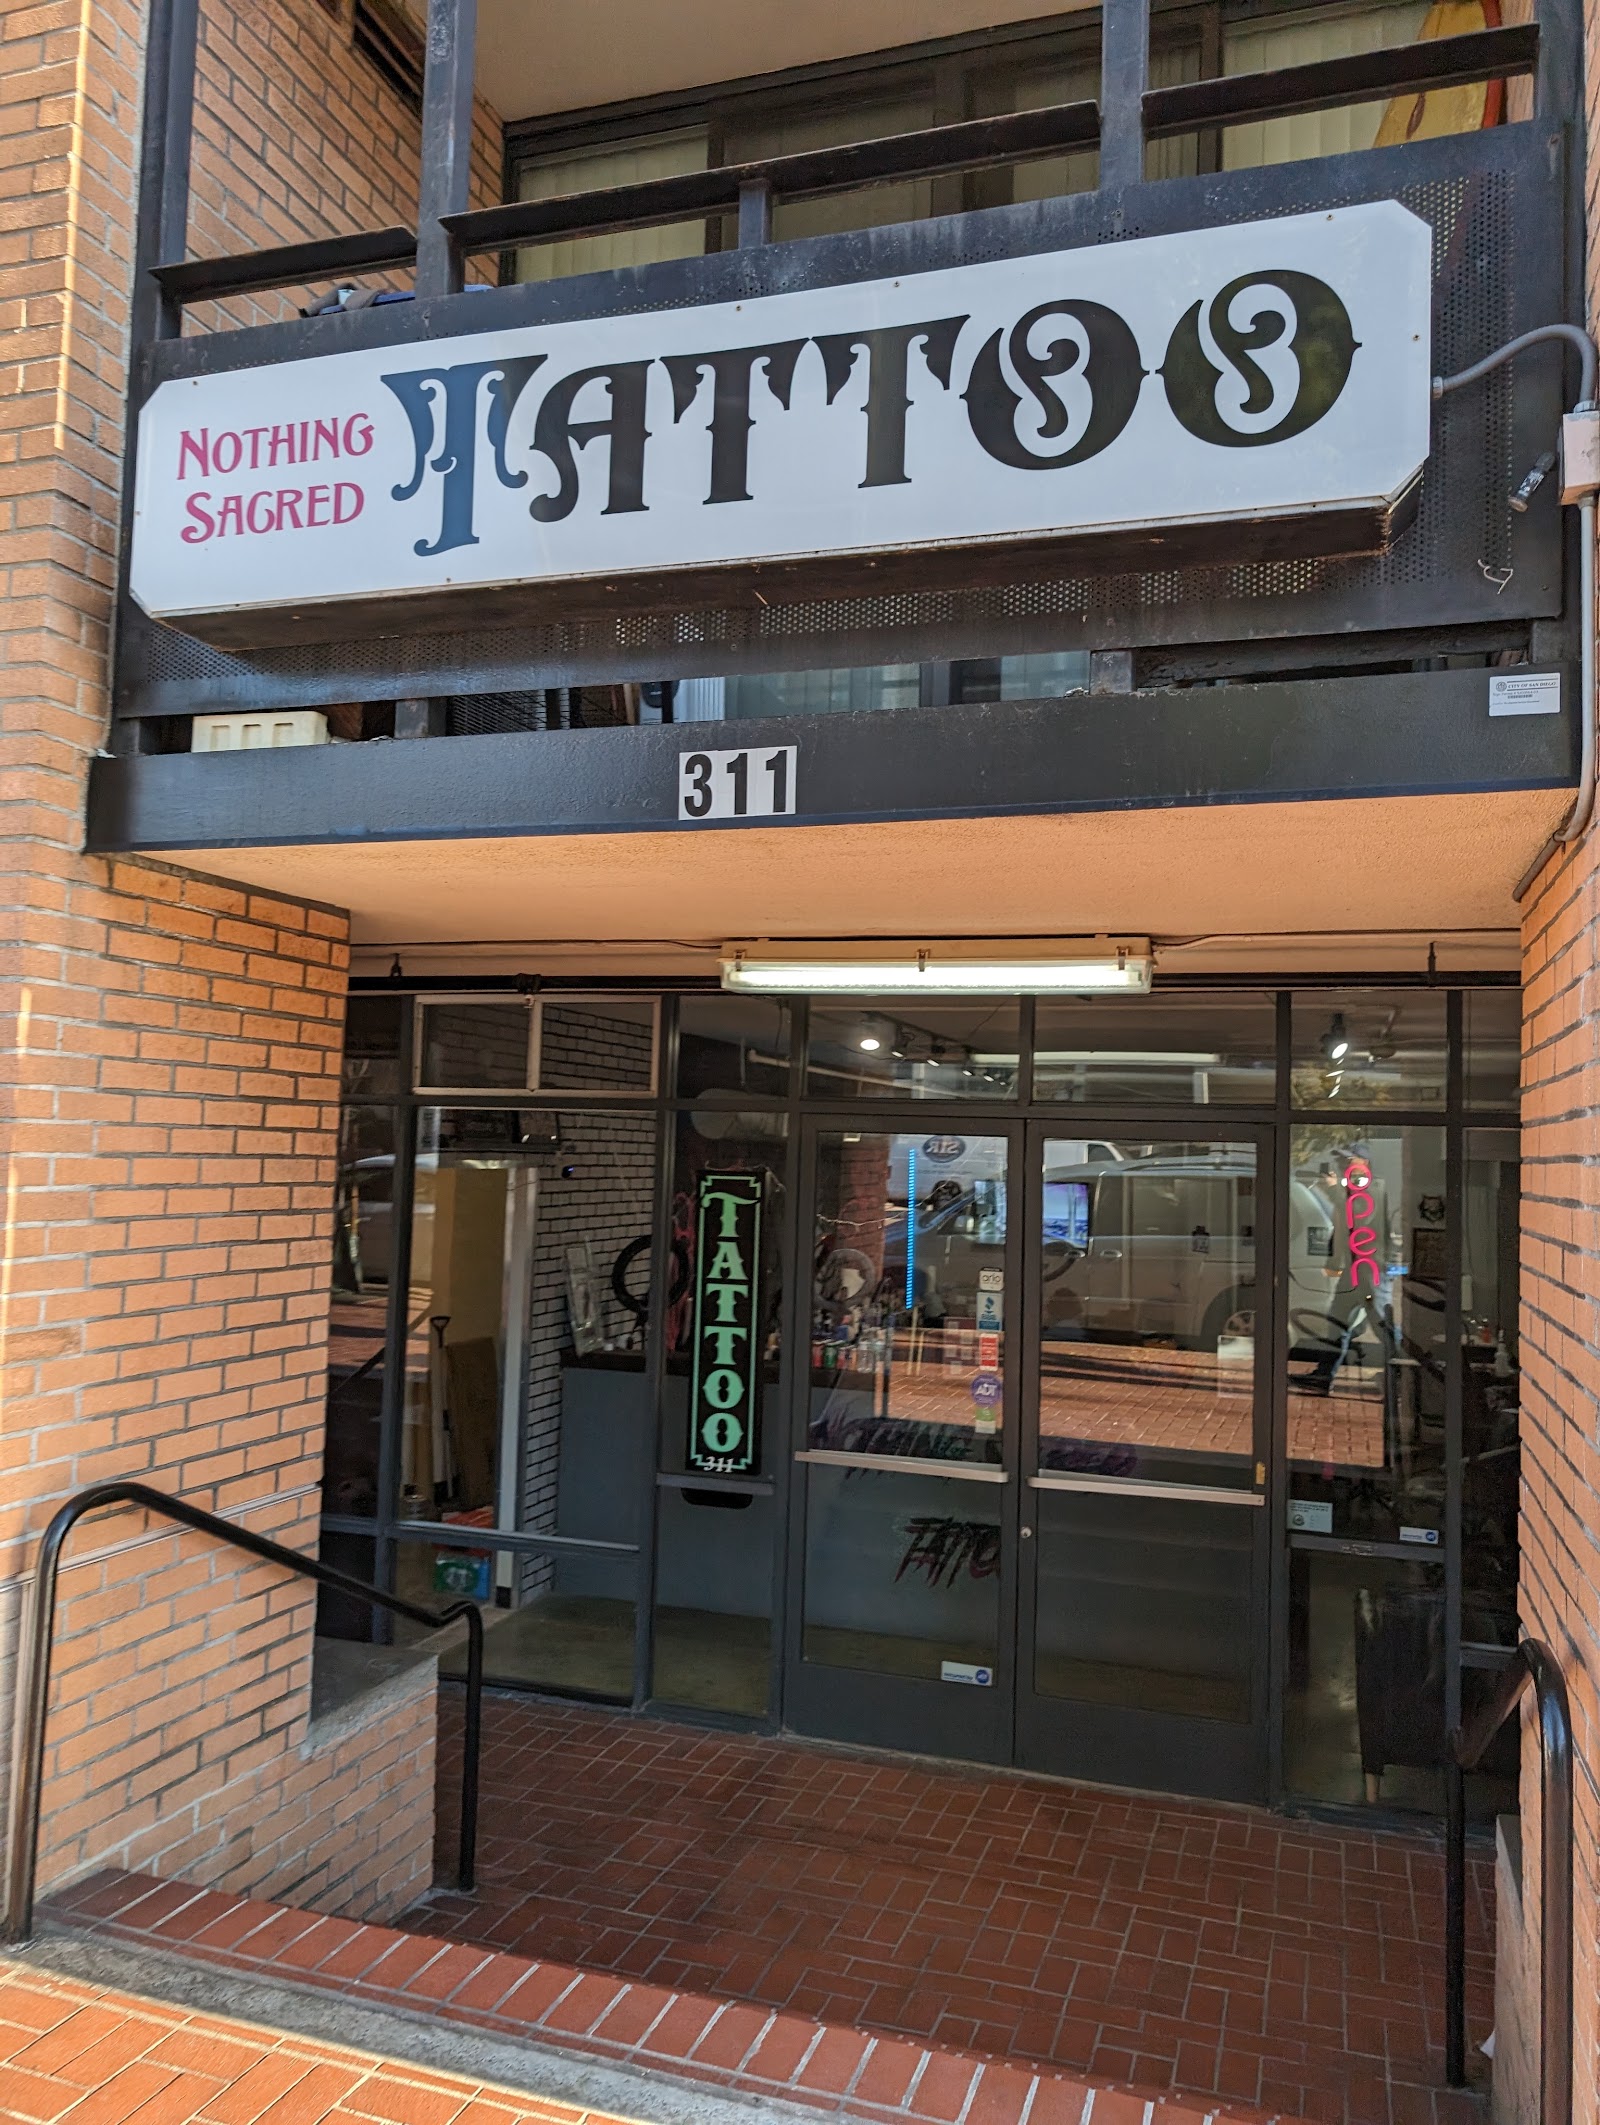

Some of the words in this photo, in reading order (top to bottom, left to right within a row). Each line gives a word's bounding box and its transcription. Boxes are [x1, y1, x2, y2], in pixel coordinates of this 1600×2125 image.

[177, 413, 375, 480] NOTHING
[381, 269, 1362, 557] TATTOO
[180, 482, 364, 543] SACRED
[684, 749, 788, 817] 311
[1344, 1164, 1380, 1287] open
[702, 1193, 759, 1452] TATTOO
[975, 1383, 998, 1397] ADT
[703, 1456, 734, 1473] 311
